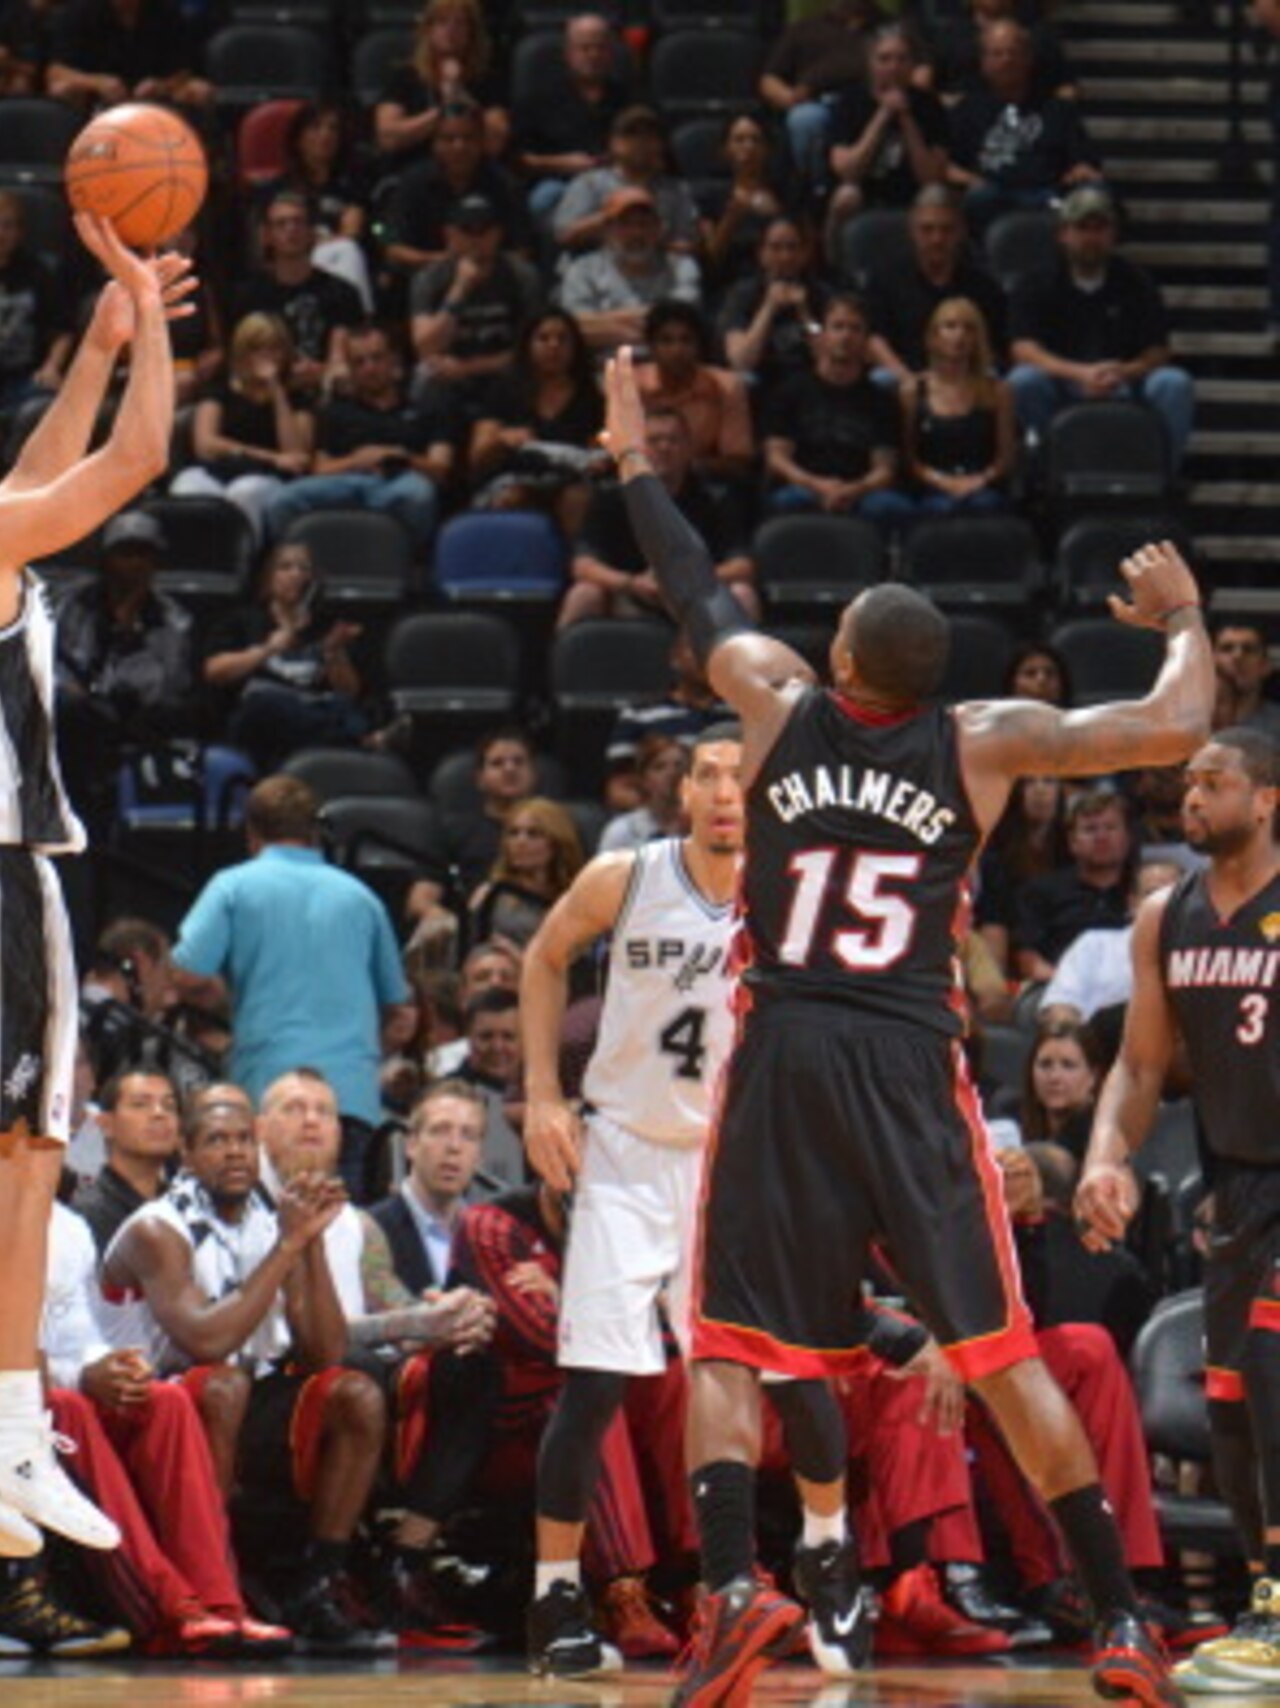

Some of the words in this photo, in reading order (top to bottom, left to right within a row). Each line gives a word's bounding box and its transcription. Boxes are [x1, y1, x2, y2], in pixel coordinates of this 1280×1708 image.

[767, 764, 956, 844] CHALMERS
[777, 847, 926, 972] 15
[626, 938, 728, 993] SPU
[1168, 948, 1280, 987] MIAMI
[659, 1006, 706, 1080] 4
[1236, 992, 1268, 1044] 3
